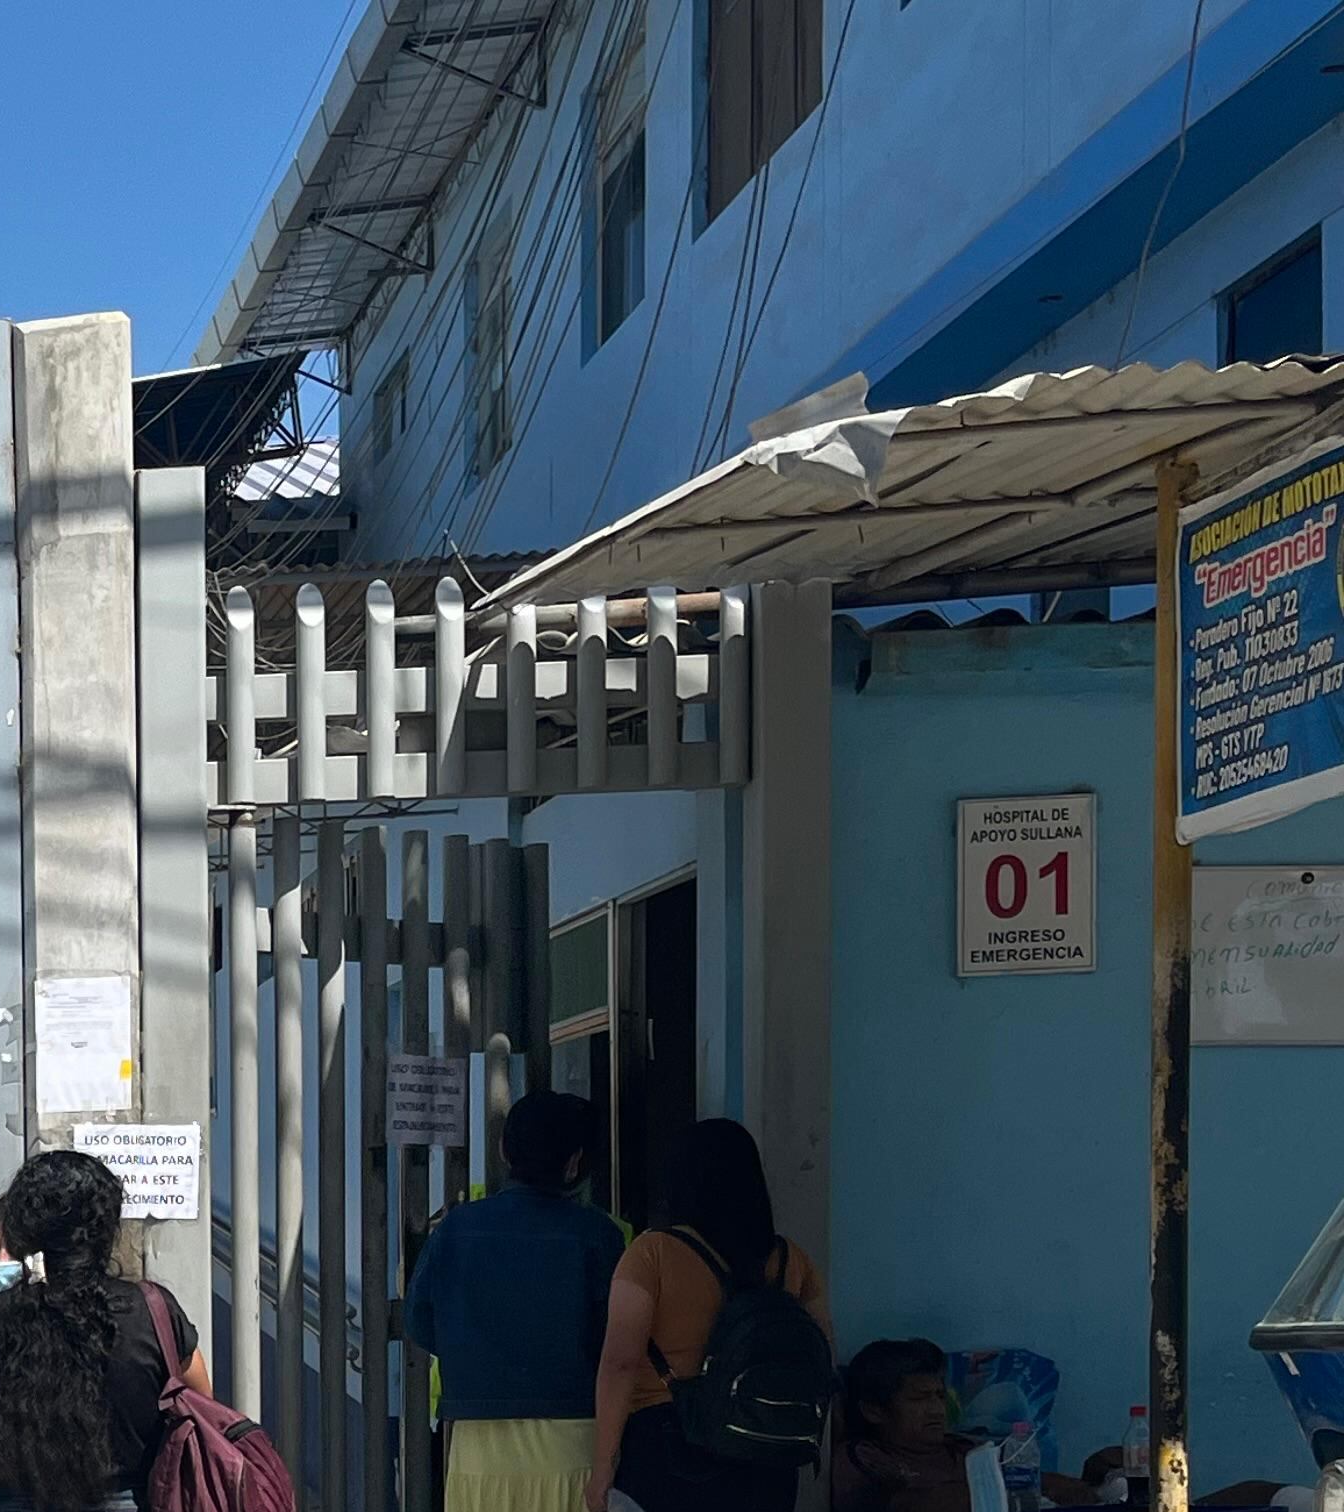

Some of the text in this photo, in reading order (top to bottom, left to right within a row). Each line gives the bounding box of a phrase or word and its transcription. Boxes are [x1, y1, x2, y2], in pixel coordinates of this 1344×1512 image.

[1189, 500, 1262, 564] ASOCIACIÓN
[1262, 490, 1281, 528] DE
[1195, 617, 1238, 652] Paradero
[1241, 604, 1264, 636] Fijo
[1283, 589, 1299, 618] 22
[1217, 643, 1241, 673] Pub.
[1195, 675, 1240, 711] Fundado:
[1242, 664, 1259, 693] 07
[1259, 652, 1306, 687] Octubre
[1195, 701, 1248, 741] Resolución
[1249, 678, 1307, 720] Gerencial
[983, 807, 1070, 825] HOSPITAL DE
[970, 825, 1083, 844] APOYO SULLANA
[985, 851, 1069, 919] 01
[988, 928, 1066, 945] INGRESO
[970, 945, 1084, 964] EMERGENCIA
[85, 1134, 187, 1147] USO OBLIGATORIO
[162, 1154, 193, 1166] PARA
[141, 1174, 149, 1185] A
[153, 1174, 179, 1185] ESTE
